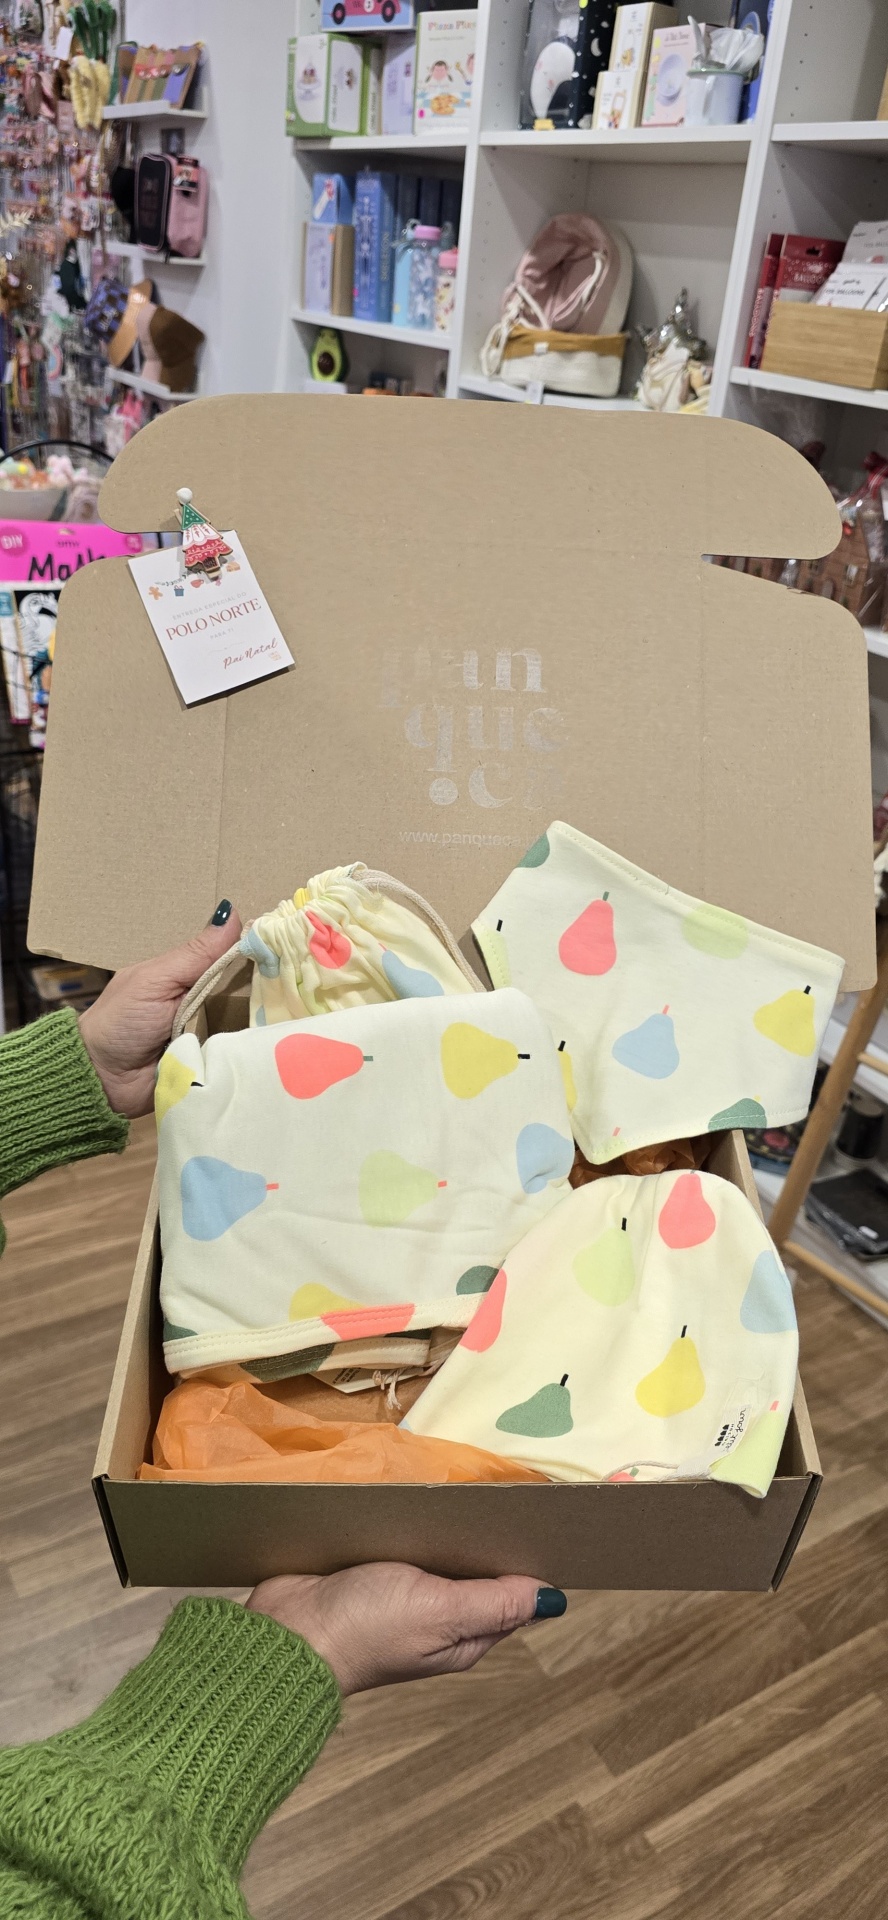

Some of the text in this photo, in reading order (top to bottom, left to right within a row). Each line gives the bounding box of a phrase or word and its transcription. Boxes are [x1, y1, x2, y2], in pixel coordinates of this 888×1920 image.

[166, 598, 262, 641] POLO NORTE
[172, 607, 203, 620] ENTREGA
[204, 595, 235, 610] ESPECIAL
[210, 630, 227, 640] PARA
[223, 637, 278, 670] Pai Natal
